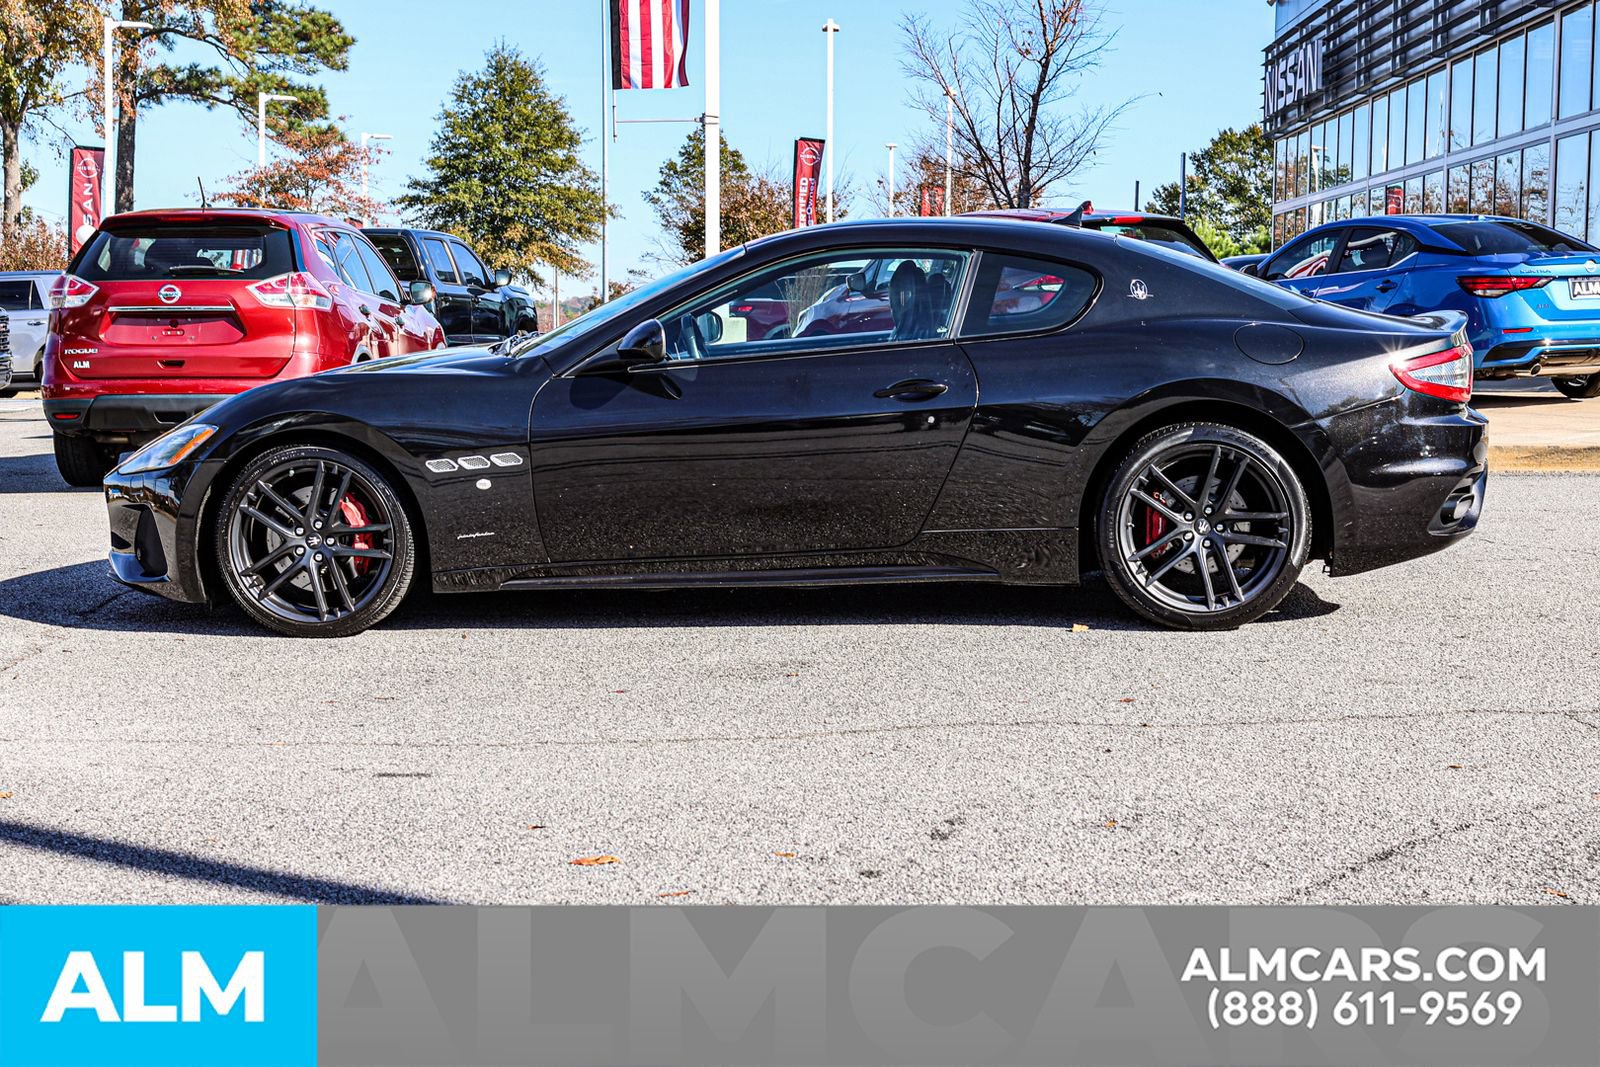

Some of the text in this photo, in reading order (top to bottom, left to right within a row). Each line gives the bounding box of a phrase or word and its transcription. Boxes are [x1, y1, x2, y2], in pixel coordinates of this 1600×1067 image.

[1265, 40, 1323, 118] NISSAN
[83, 182, 93, 225] SAN
[799, 177, 808, 227] ERTIFIED
[806, 177, 815, 226] e-Owned
[1573, 281, 1600, 296] ALM
[73, 360, 90, 369] ALM
